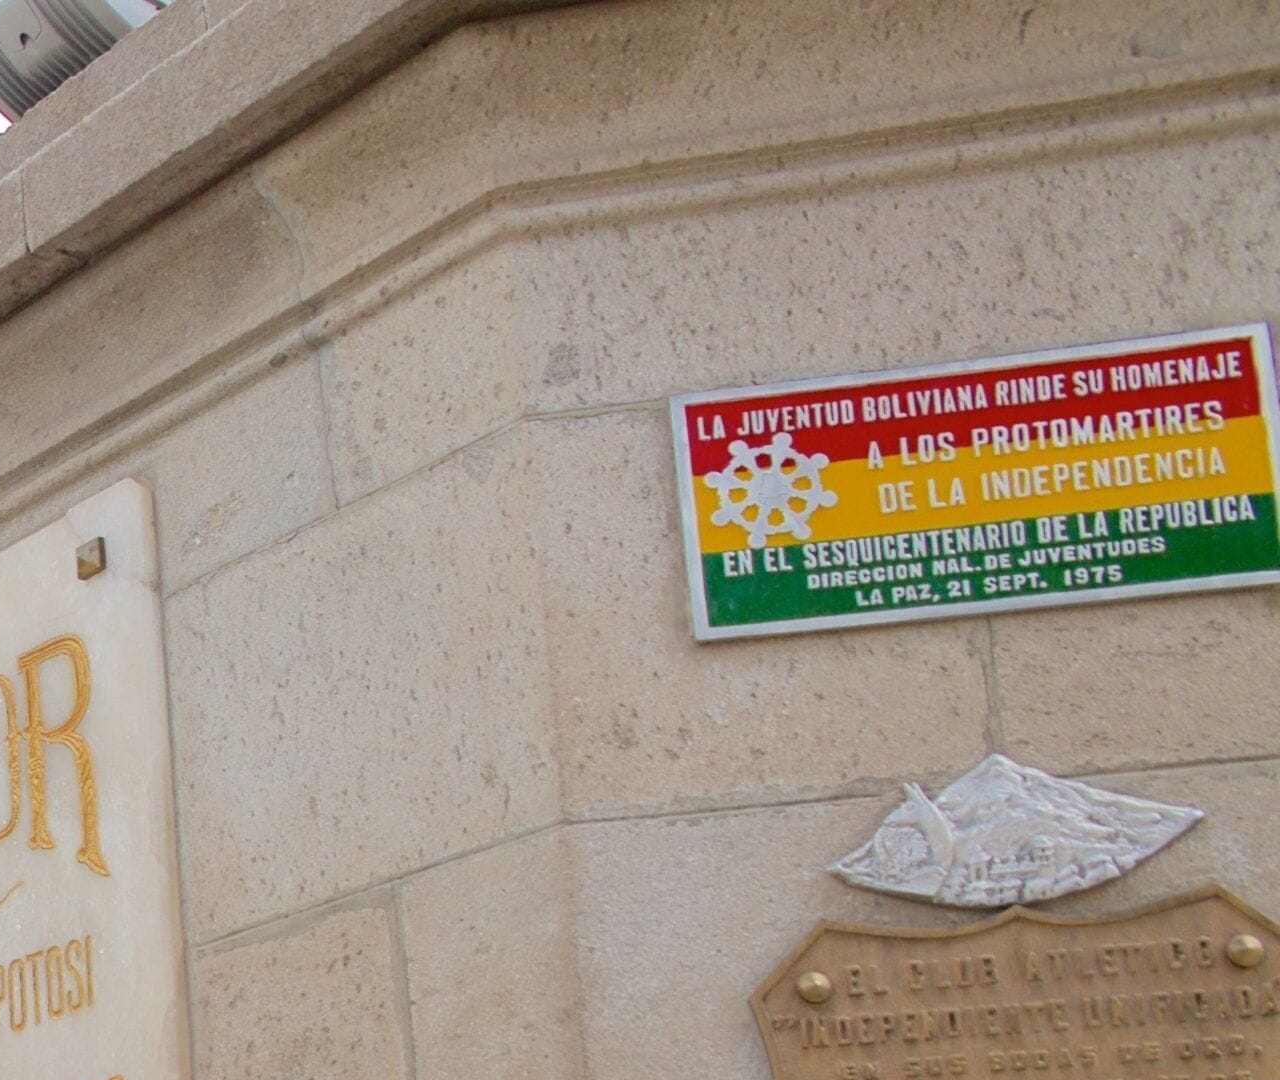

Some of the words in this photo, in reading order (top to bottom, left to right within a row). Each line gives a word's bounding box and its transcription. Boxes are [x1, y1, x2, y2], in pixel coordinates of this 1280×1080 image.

[697, 414, 726, 441] LA
[737, 400, 856, 436] JUVENTUD
[862, 383, 988, 423] BOLIVIANA
[995, 373, 1067, 407] RINDE
[1072, 368, 1104, 396] SU
[1110, 351, 1243, 392] HOMENAJE
[867, 441, 884, 470] A
[899, 431, 957, 466] LOS
[971, 400, 1226, 458] PROTOMARTIRES
[878, 480, 917, 514] DE
[927, 477, 967, 509] LA
[980, 446, 1227, 501] INDEPENDENCIA
[722, 549, 754, 578] EN
[763, 547, 793, 572] EL
[802, 519, 1026, 569] SESQUICENTENARIO
[1036, 515, 1069, 544] DE
[1077, 510, 1109, 539] LA
[1119, 493, 1257, 535] REPUBLICA
[807, 562, 923, 590] DIRECCION
[1017, 536, 1167, 567] JUVENTUDES
[855, 589, 883, 608] LA
[892, 583, 940, 603] PAZ,
[947, 579, 971, 598] 21
[983, 571, 1048, 594] SEPT.
[1064, 564, 1124, 587] 1975
